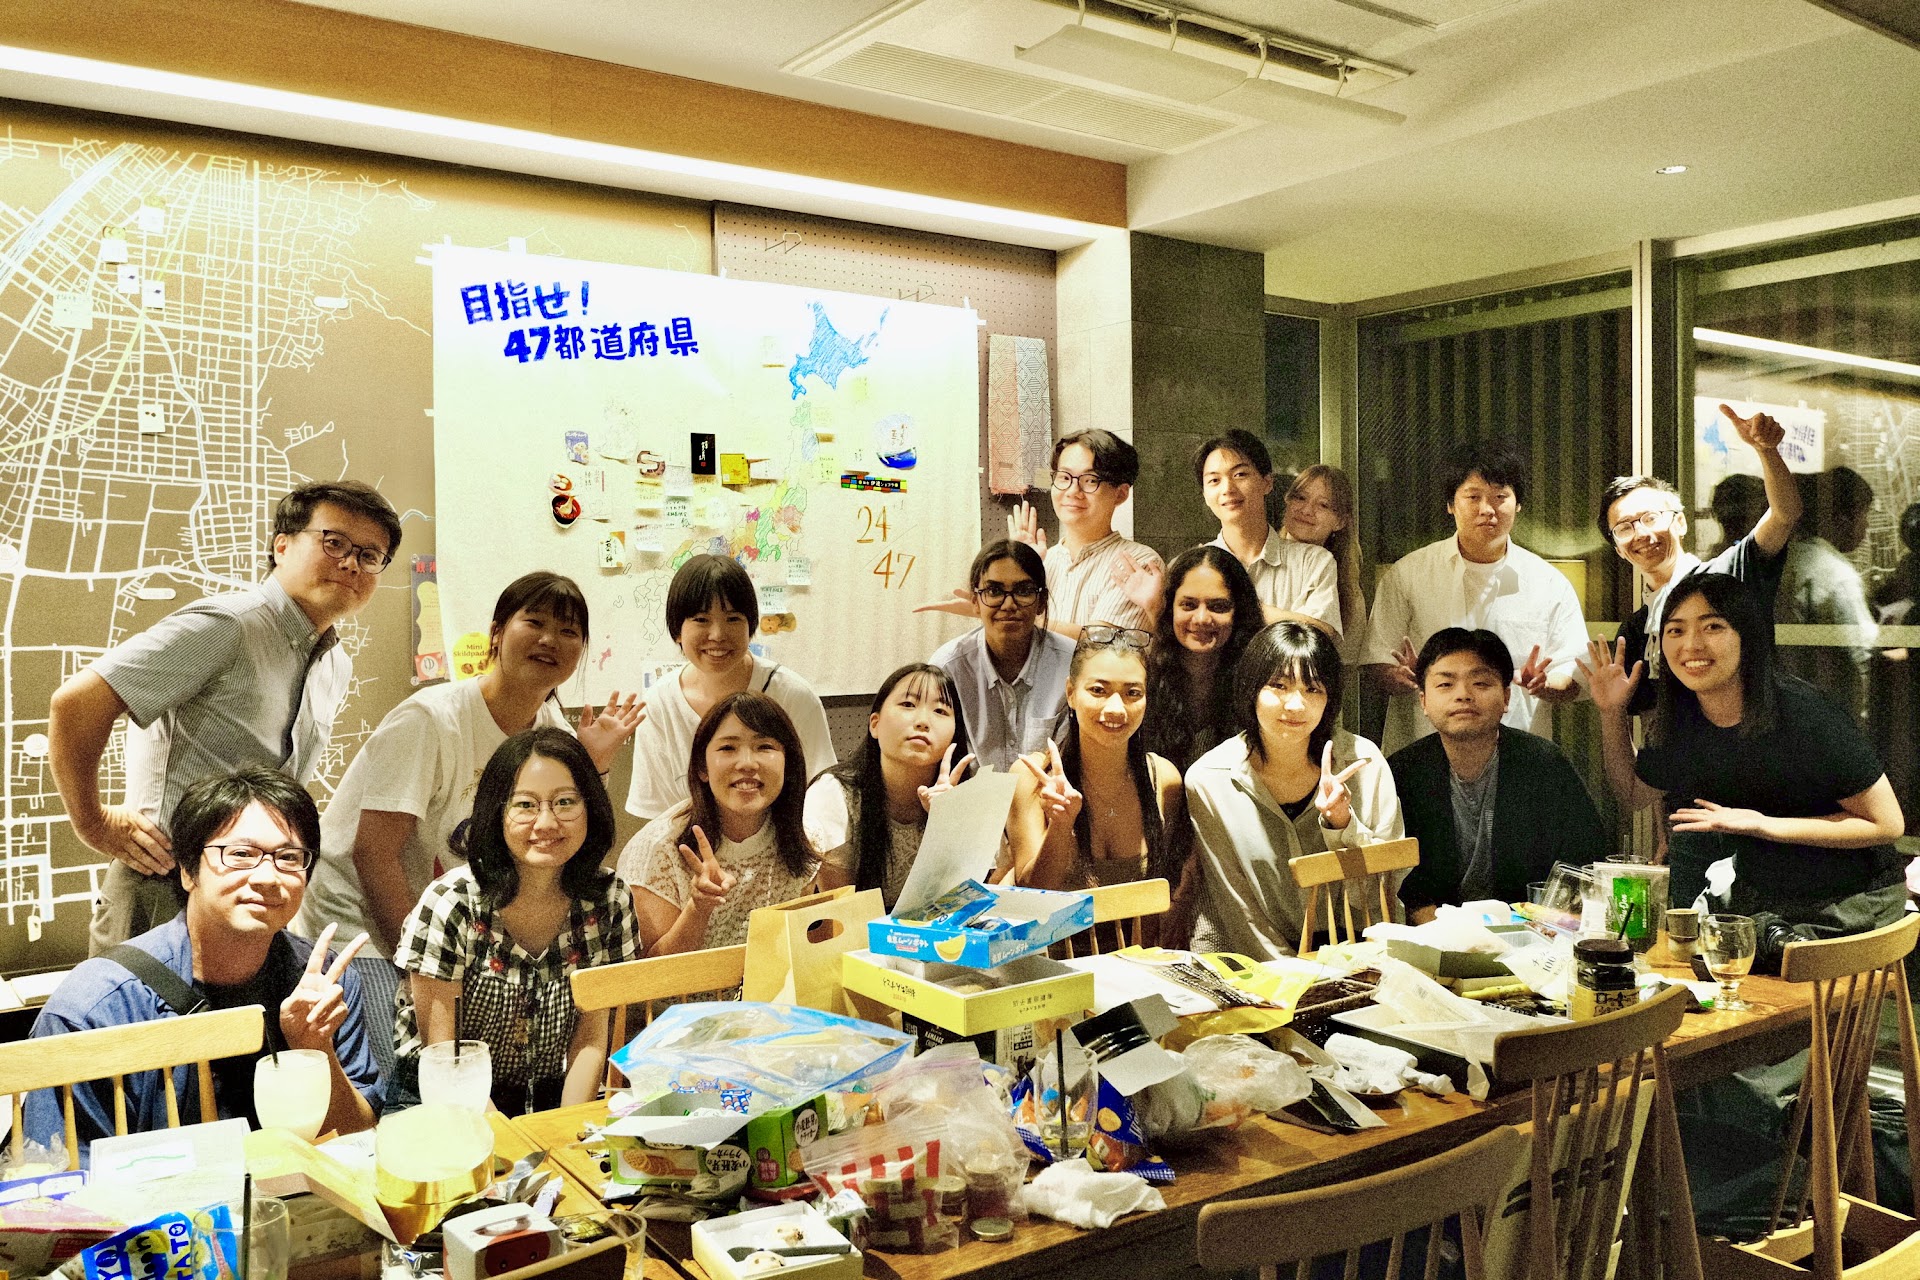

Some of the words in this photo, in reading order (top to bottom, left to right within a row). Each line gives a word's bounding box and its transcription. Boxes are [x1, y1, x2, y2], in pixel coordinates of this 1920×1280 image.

[460, 279, 590, 324] 目指せ！
[503, 317, 699, 363] 47都道府県
[857, 506, 892, 543] 24
[873, 549, 916, 589] 47
[711, 1149, 741, 1158] クラッカー
